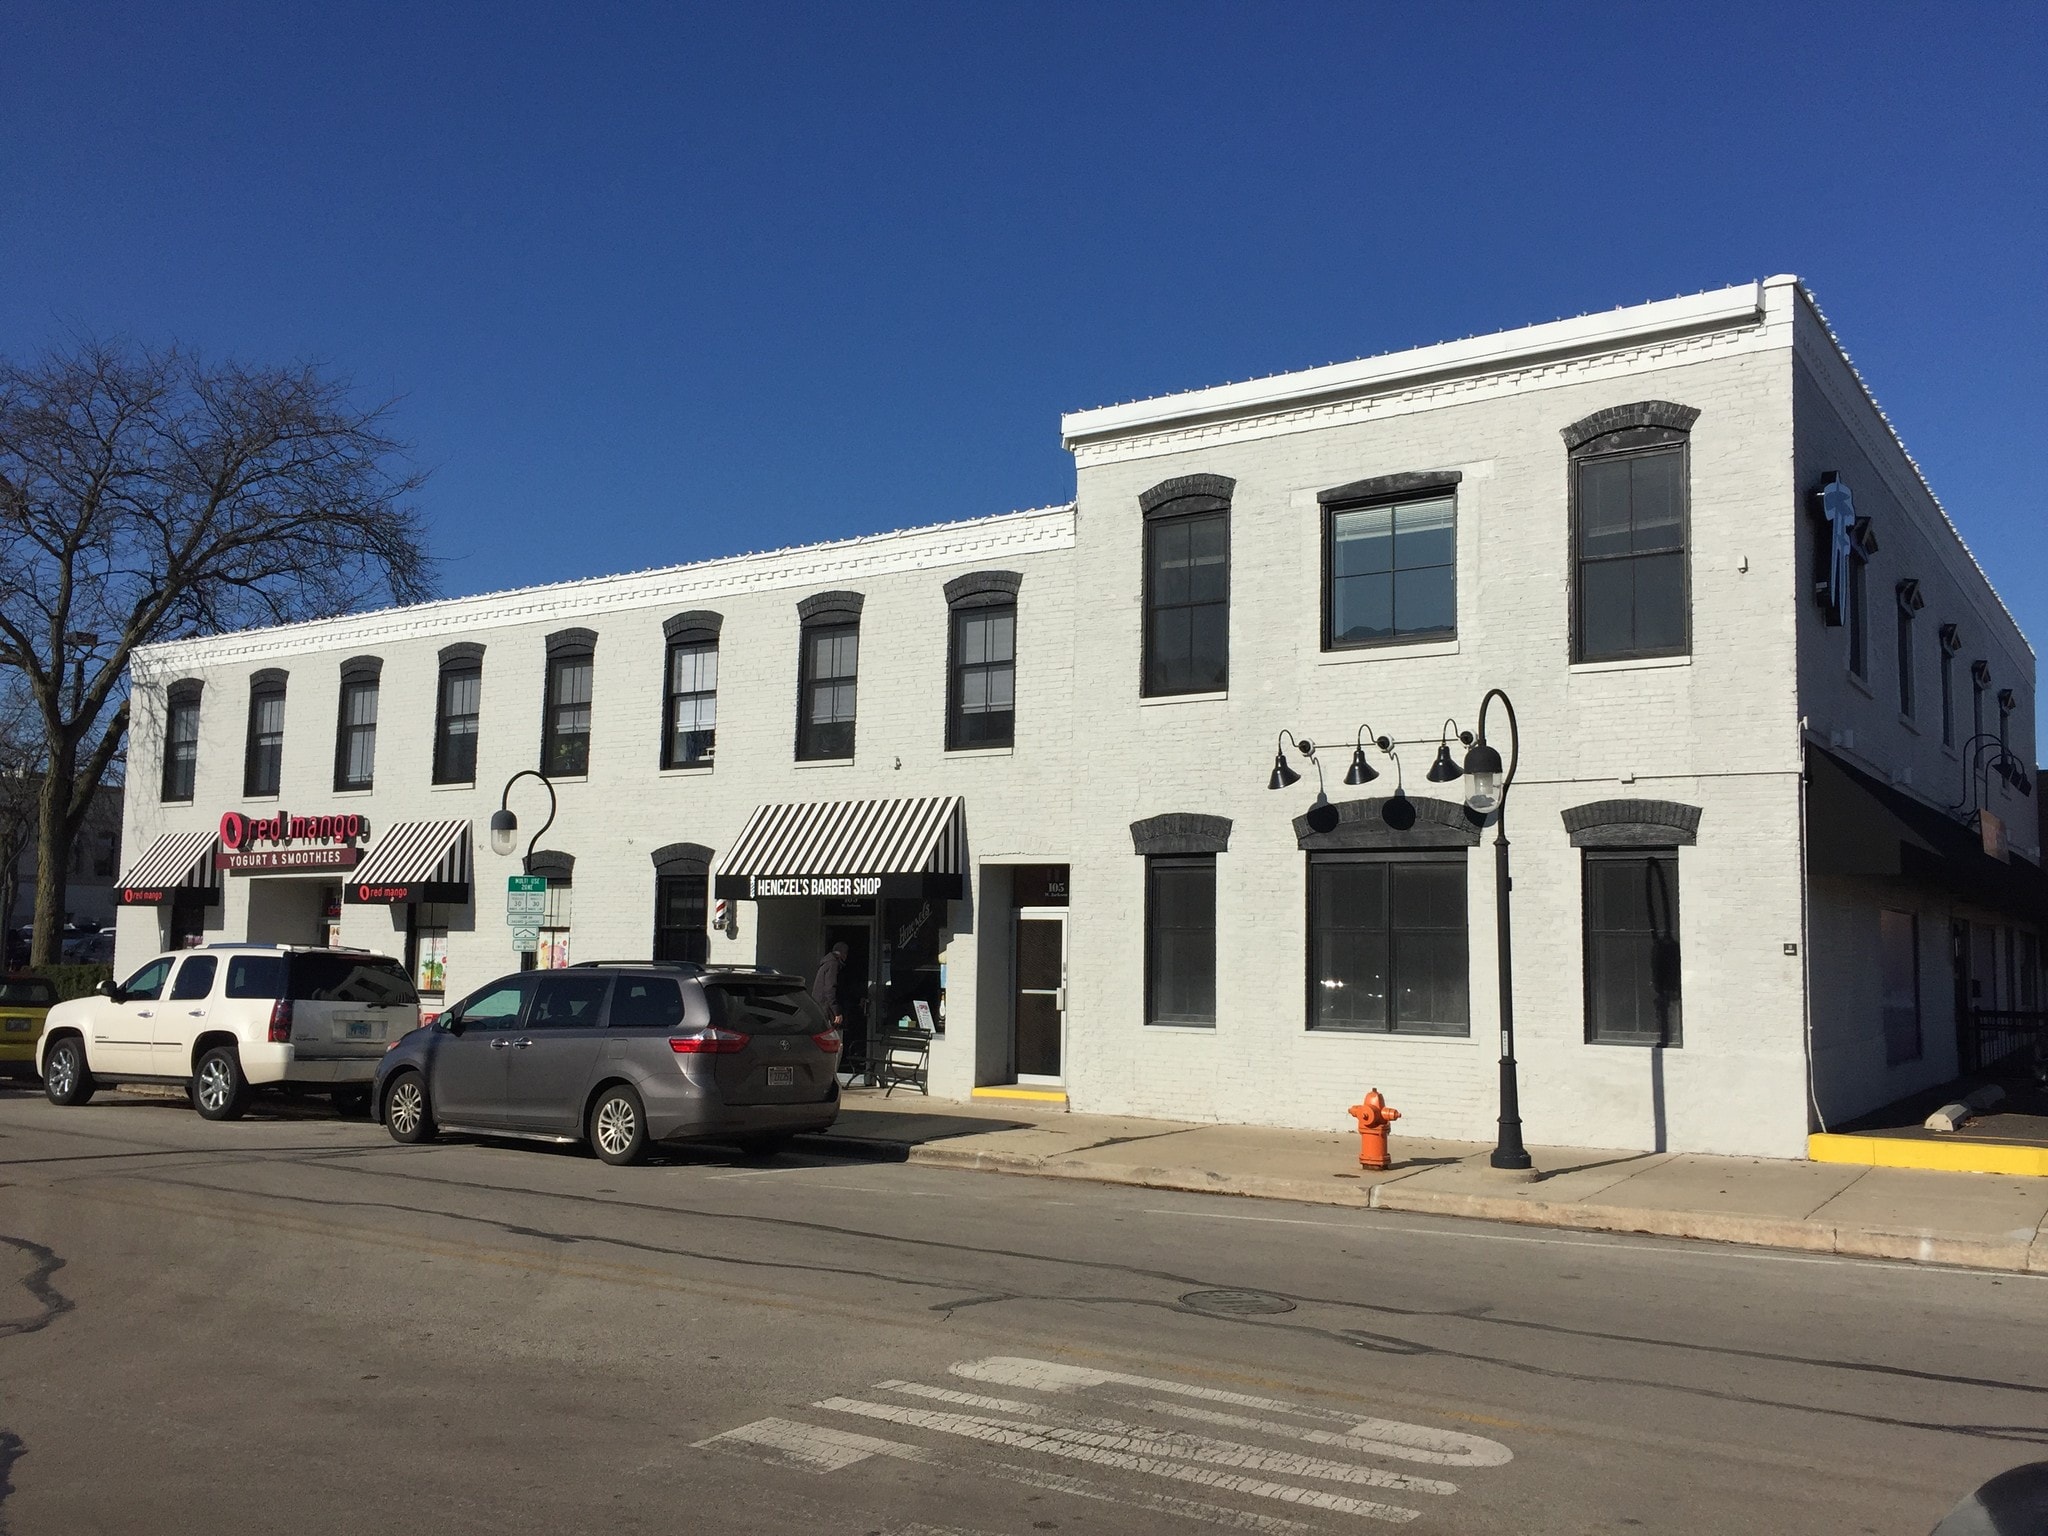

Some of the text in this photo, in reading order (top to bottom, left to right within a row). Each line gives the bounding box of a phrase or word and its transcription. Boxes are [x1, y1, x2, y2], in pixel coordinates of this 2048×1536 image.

[249, 811, 359, 844] red mango
[229, 851, 341, 867] YOGURT & SMOOTHIES
[370, 887, 408, 899] red mango
[757, 877, 882, 896] HENCZEL'S BARBER SHOP
[1048, 882, 1065, 893] 105
